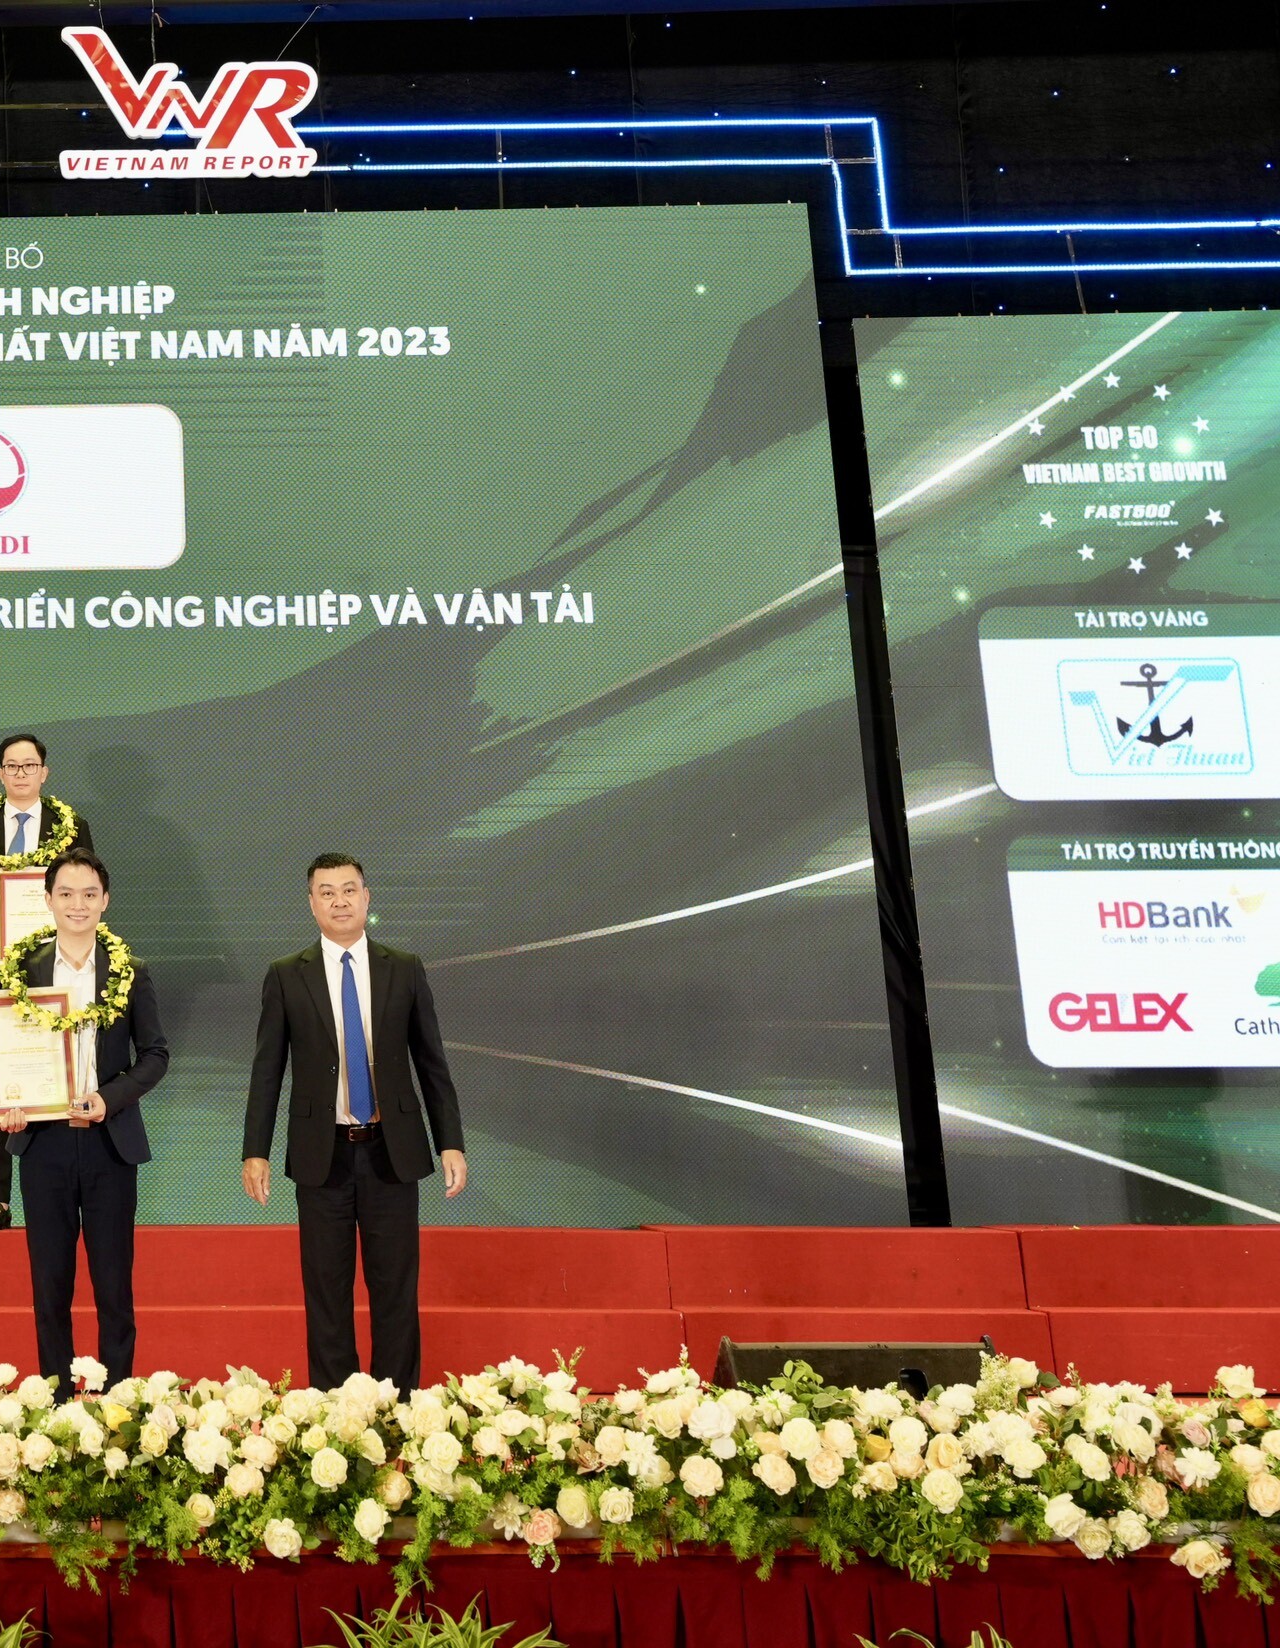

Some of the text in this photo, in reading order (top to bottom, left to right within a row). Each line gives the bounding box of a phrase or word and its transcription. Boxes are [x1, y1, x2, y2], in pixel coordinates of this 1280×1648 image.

[66, 155, 310, 172] VIETNAM REPORT
[5, 241, 44, 270] BỐ
[31, 281, 176, 321] NGHIỆP
[59, 326, 141, 367] VIỆT
[151, 329, 244, 359] NAM
[253, 323, 348, 359] NĂM
[357, 326, 451, 357] 2023
[1081, 425, 1158, 450] TOP 50
[1022, 461, 1227, 484] VIETNAM BEST GROWTH
[1083, 503, 1171, 519] FAST500
[84, 590, 205, 628] CÔNG
[215, 590, 362, 633] NGHIỆP
[370, 587, 428, 626] VÀ
[434, 587, 522, 632] VẬN
[531, 583, 594, 624] TẢI
[1075, 608, 1208, 630] TÀI TRỢ VÀNG
[1061, 841, 1092, 860] TÀI
[1094, 842, 1135, 862] TRỢ
[1138, 838, 1215, 860] TRUYỀN
[1098, 901, 1232, 928] HDBank
[1048, 992, 1194, 1032] GELEX
